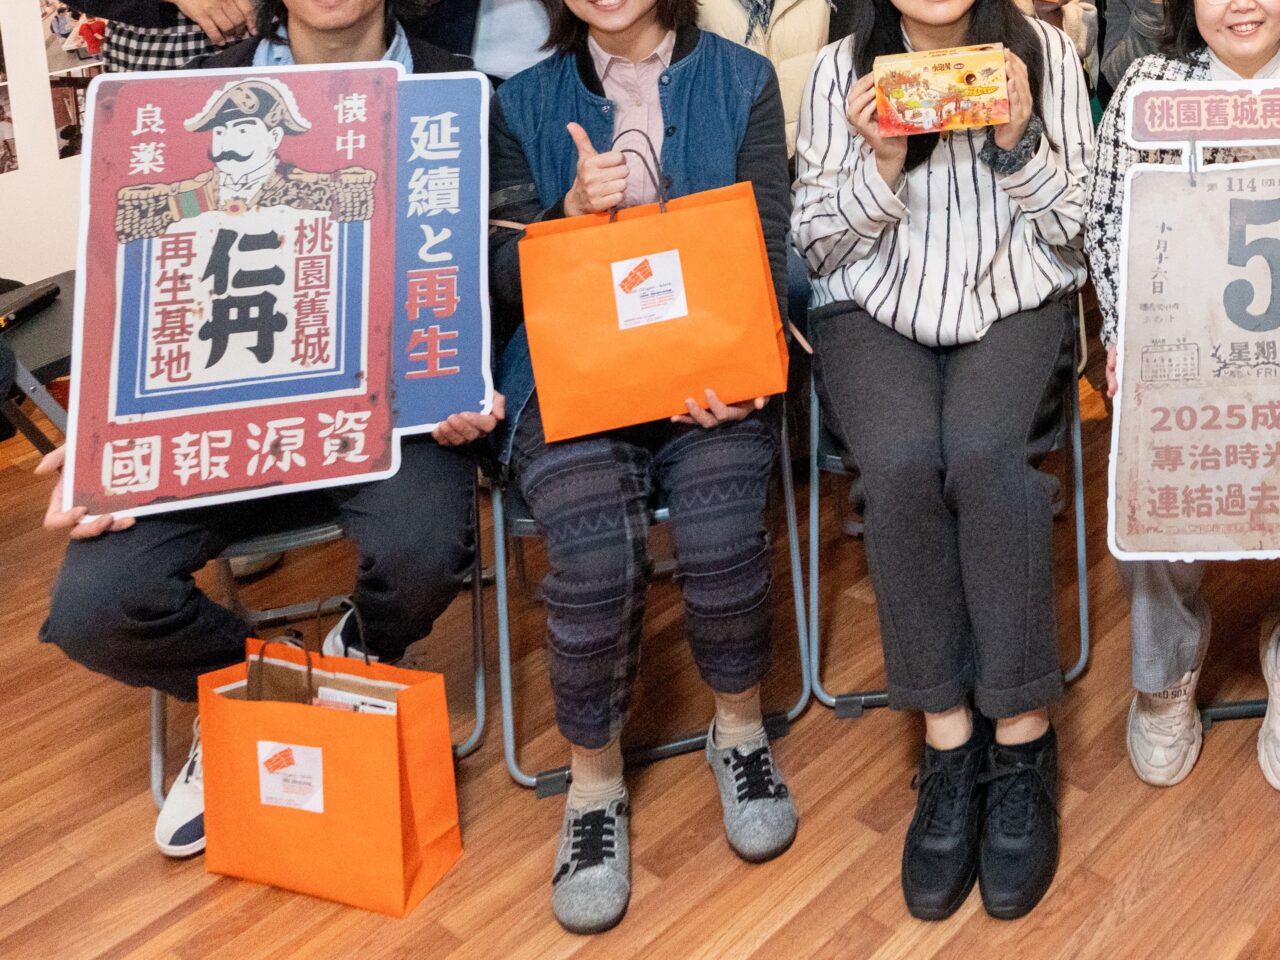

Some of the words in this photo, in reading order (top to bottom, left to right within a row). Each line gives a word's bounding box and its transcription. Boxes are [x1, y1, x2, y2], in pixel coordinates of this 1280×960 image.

[1226, 177, 1257, 192] 114
[149, 231, 197, 384] 再生基地
[198, 227, 288, 370] 仁丹
[290, 217, 334, 366] 桃園舊城
[1256, 367, 1278, 377] FRI
